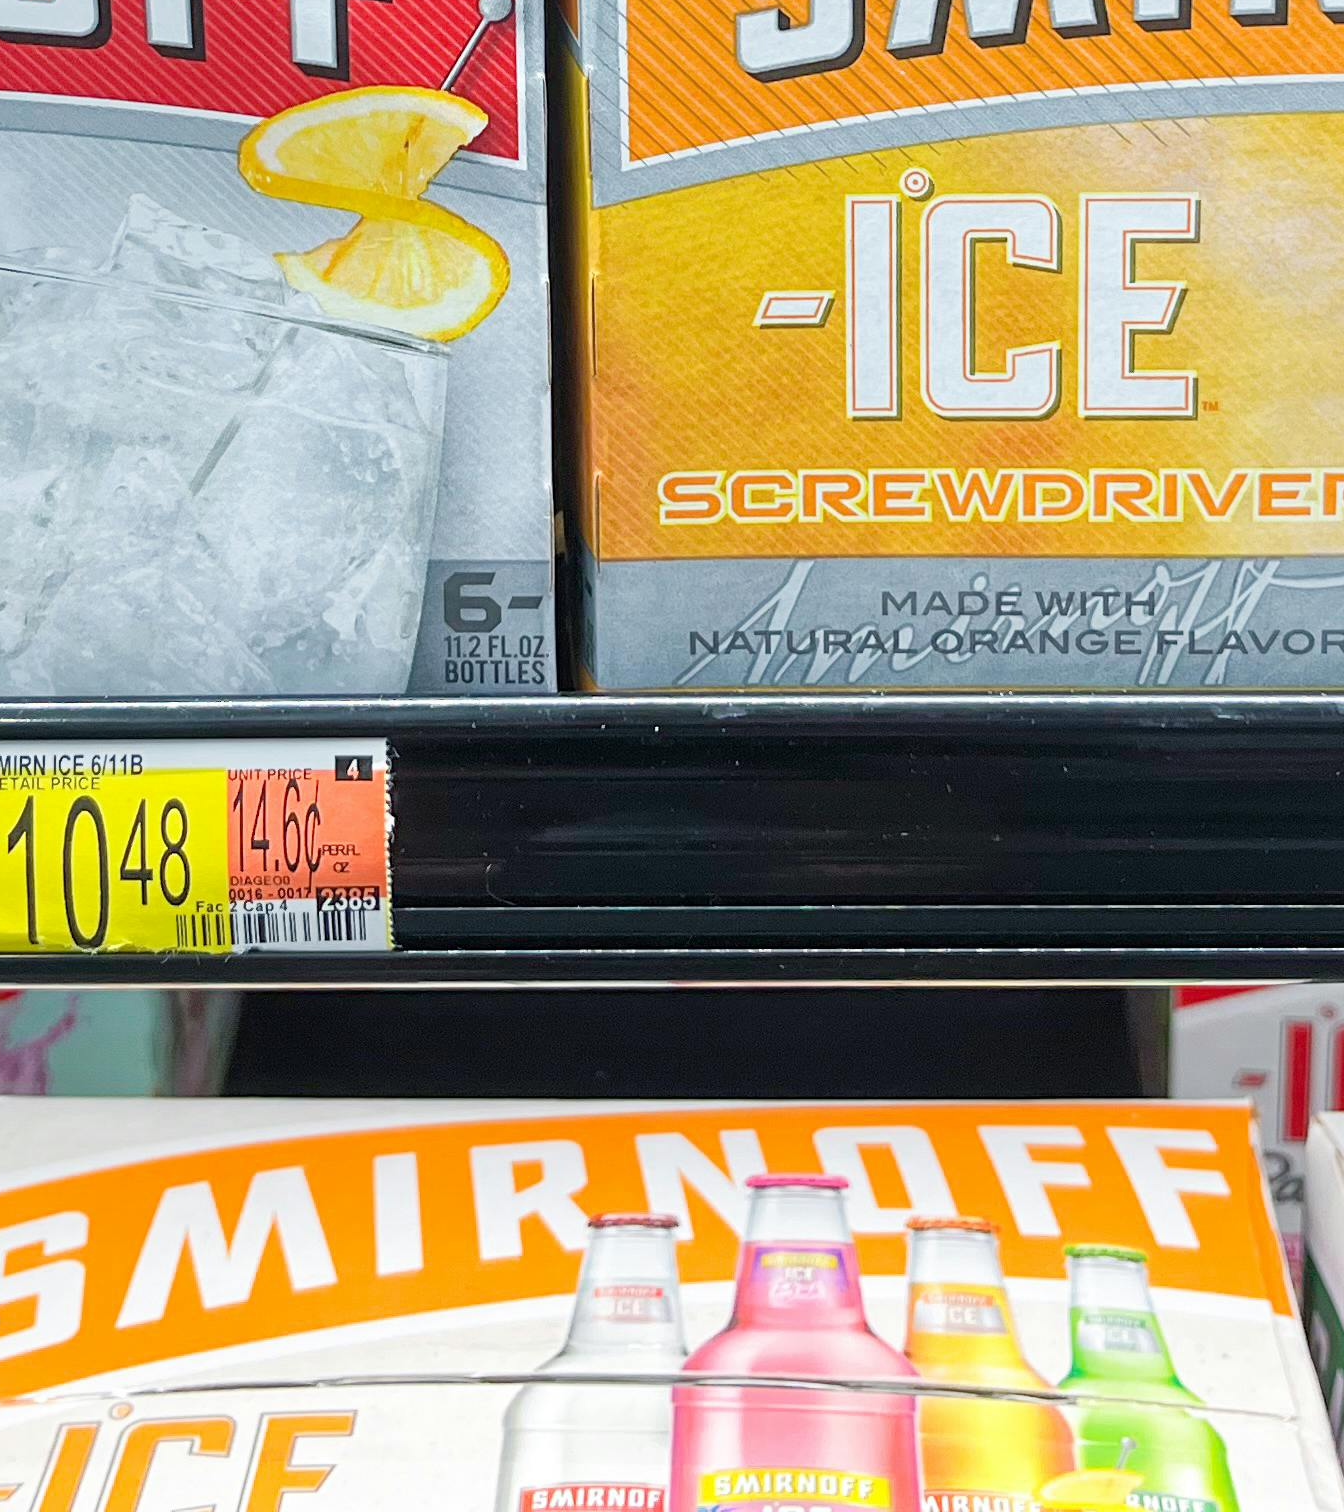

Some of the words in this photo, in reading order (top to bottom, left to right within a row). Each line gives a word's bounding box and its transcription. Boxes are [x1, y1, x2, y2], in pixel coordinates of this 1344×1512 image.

[881, 590, 1023, 617] MADE
[1036, 590, 1156, 617] WITH
[443, 635, 481, 658] 11.2
[688, 629, 929, 656] NATURAL
[947, 629, 1141, 656] ORANGE
[444, 659, 546, 685] BOTTLES
[53, 754, 84, 776] ICE
[91, 754, 143, 776] 6/11B
[228, 769, 263, 781] UNIT
[267, 768, 312, 780] PRICE
[346, 758, 360, 780] 4
[51, 777, 101, 790] PRICE
[229, 888, 263, 901] 0016
[277, 888, 311, 900] 0017
[319, 887, 378, 911] 2385
[196, 900, 224, 913] Fac
[230, 900, 238, 913] 2
[243, 899, 274, 916] Cap
[279, 899, 288, 911] 4
[713, 1470, 884, 1498] SMIRNOFF
